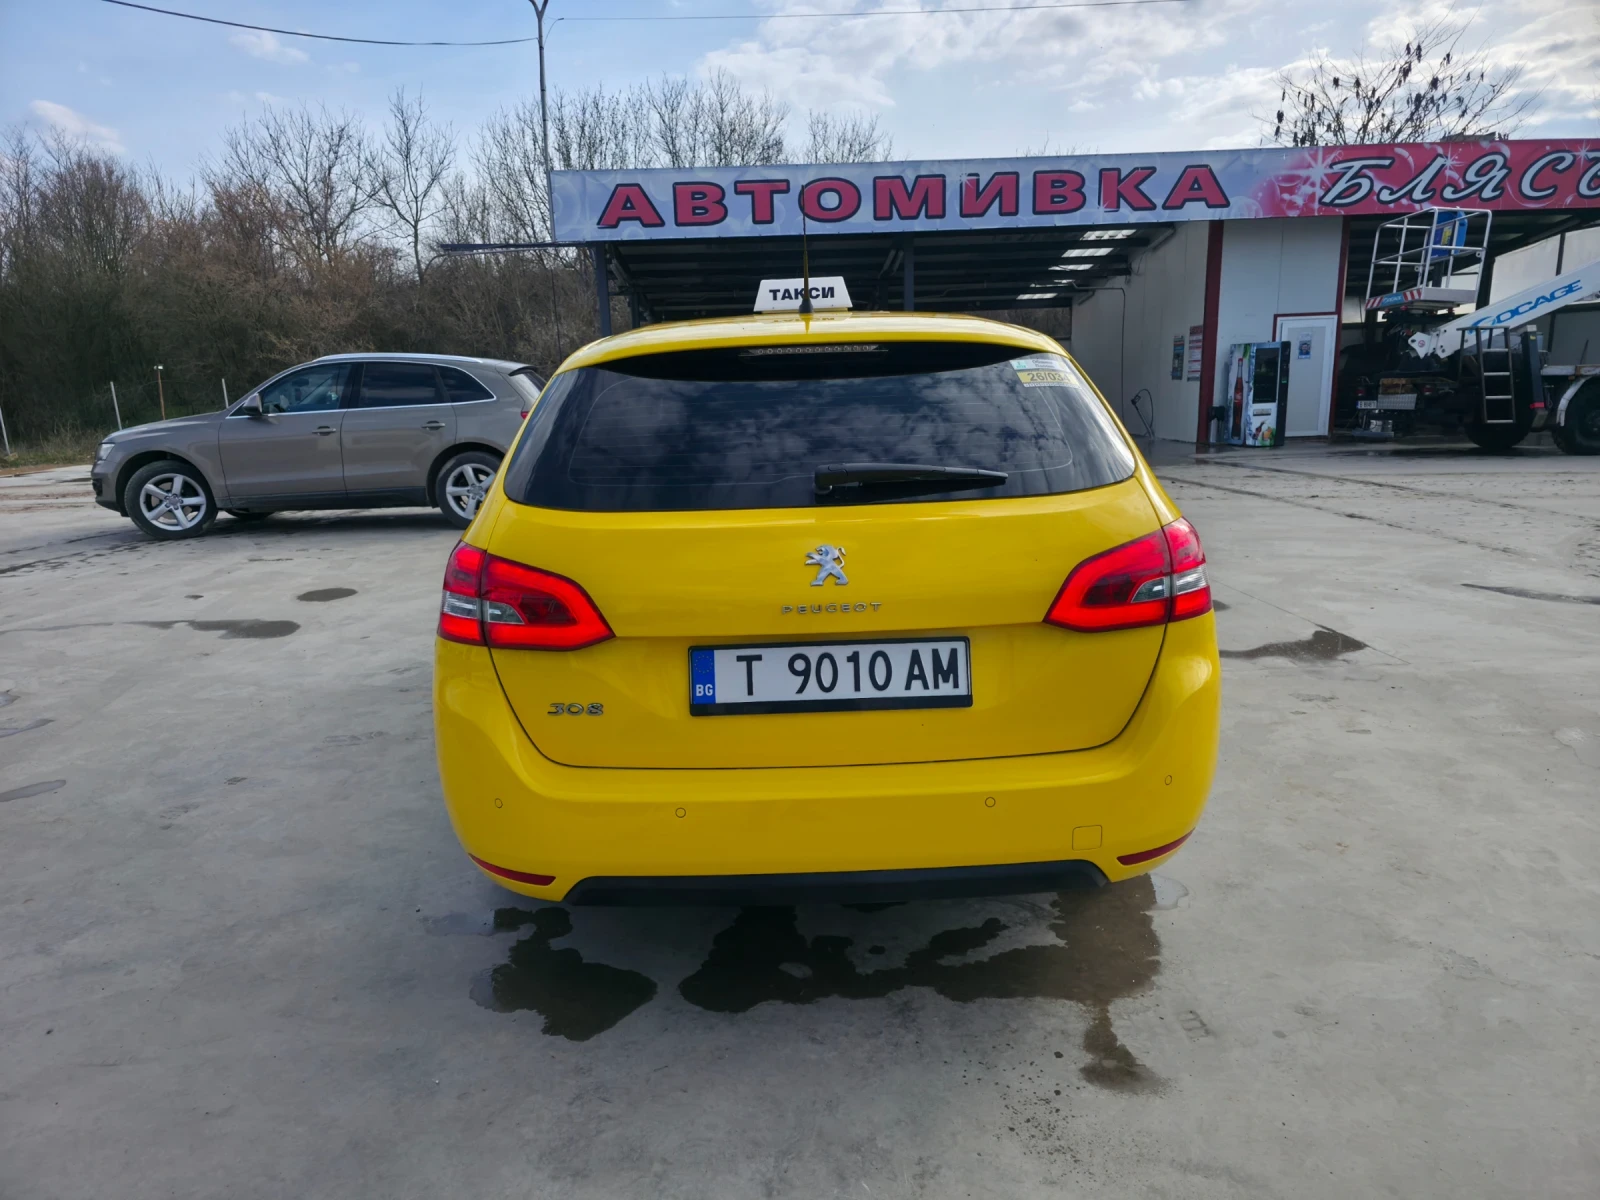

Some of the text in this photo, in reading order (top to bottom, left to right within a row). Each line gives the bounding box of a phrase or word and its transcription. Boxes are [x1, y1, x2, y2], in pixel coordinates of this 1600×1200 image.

[597, 164, 1230, 229] АВТОМИВКА
[769, 287, 835, 301] ТАКСИ
[782, 602, 883, 614] PEUGEOT
[736, 648, 960, 696] T 9010 AM
[695, 683, 714, 697] BG
[547, 702, 604, 716] 308
